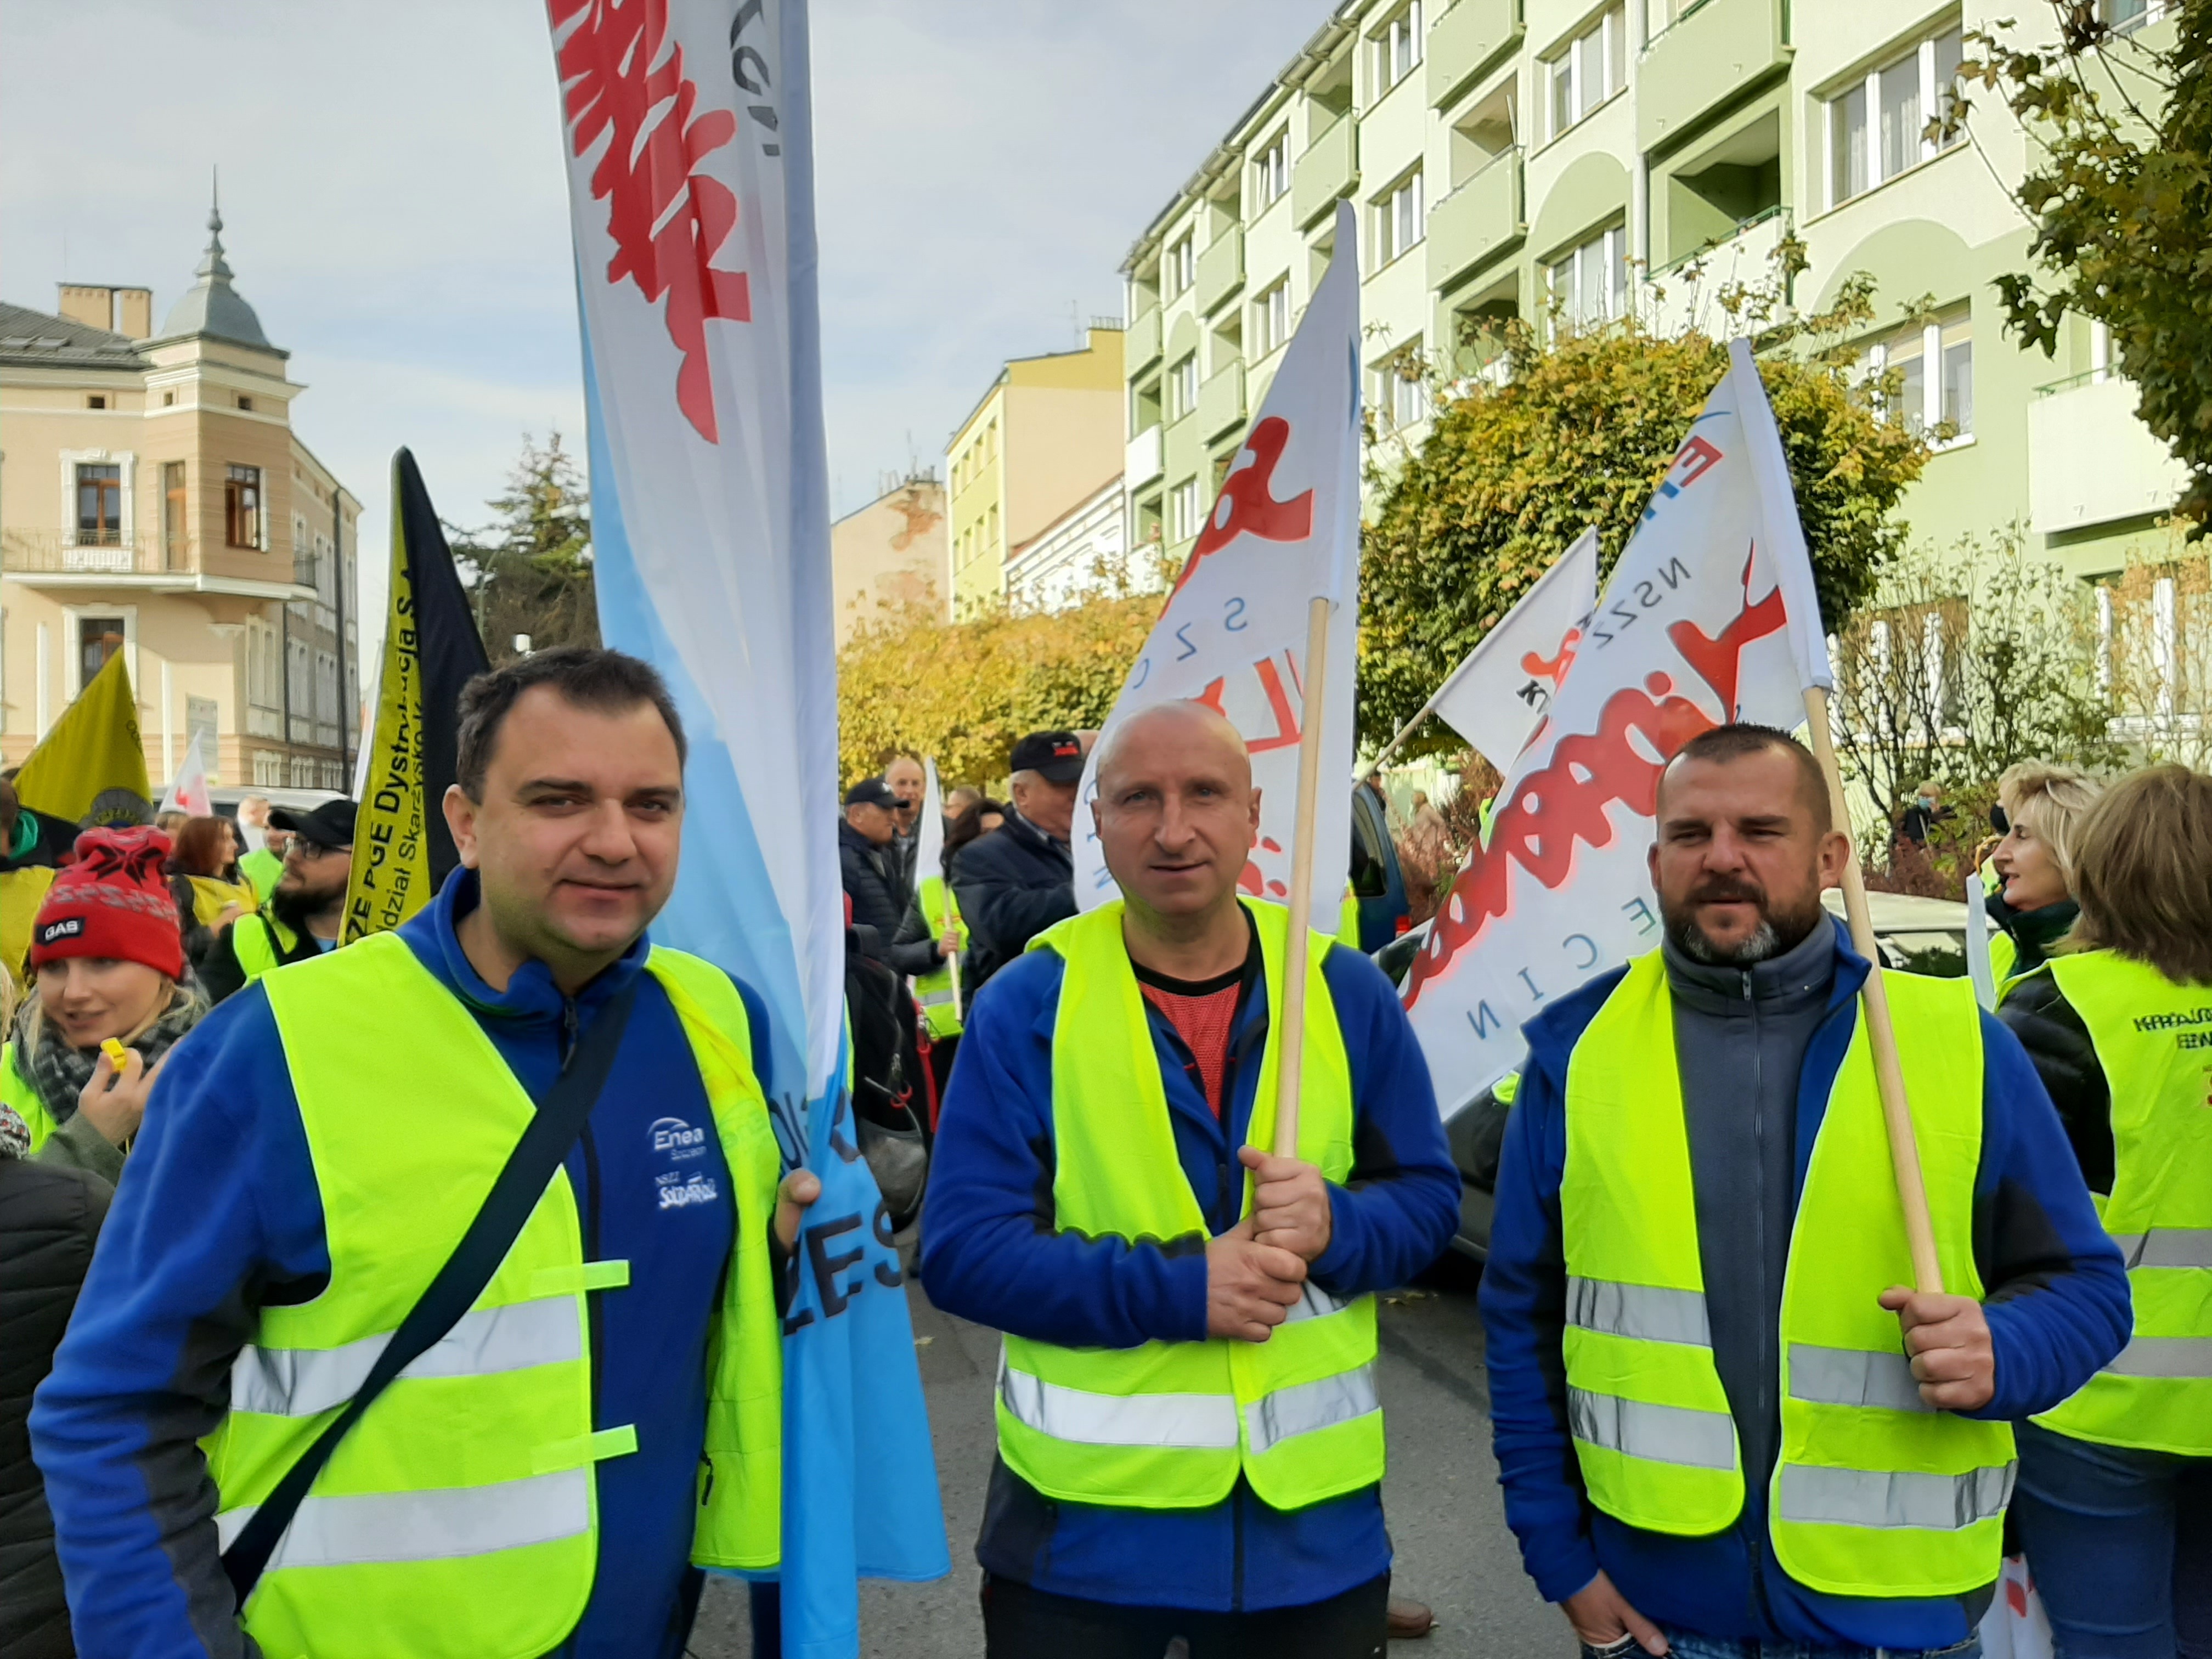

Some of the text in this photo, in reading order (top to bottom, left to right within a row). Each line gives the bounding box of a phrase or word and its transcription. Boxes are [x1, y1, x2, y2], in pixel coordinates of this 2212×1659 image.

[363, 822, 393, 890] PGE
[376, 867, 411, 932] dział
[45, 921, 78, 941] GAS
[654, 1127, 705, 1152] Enea
